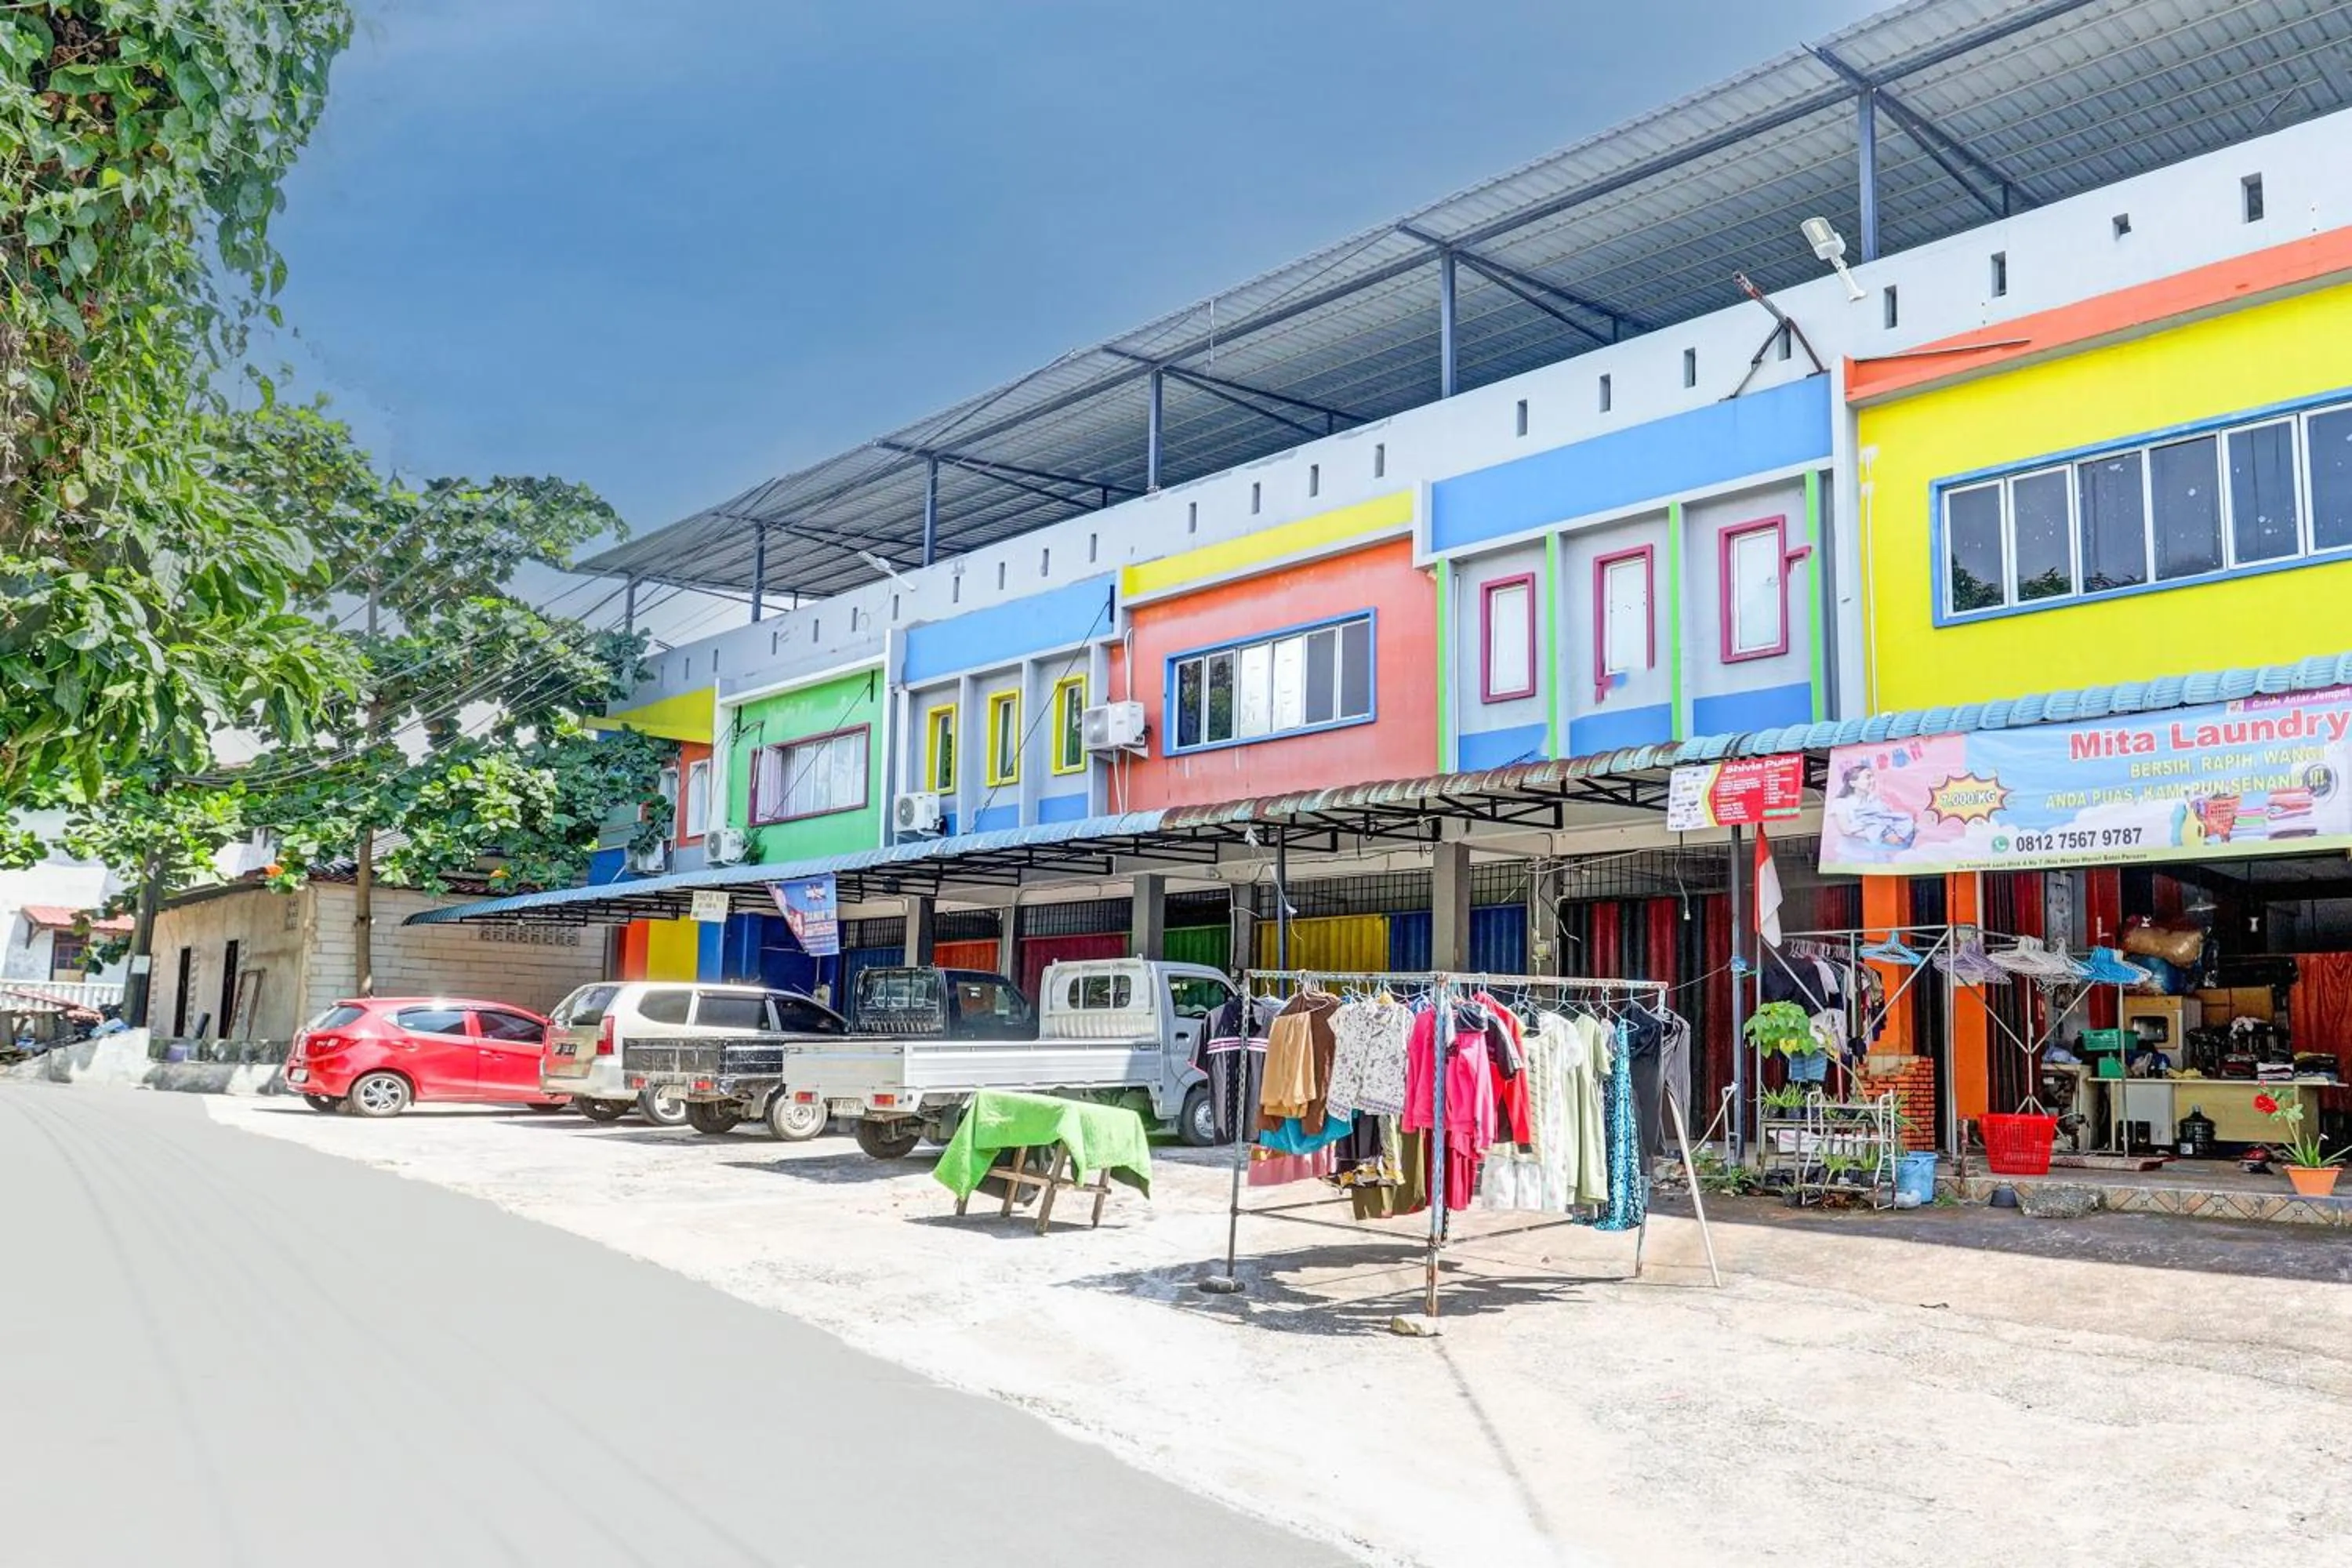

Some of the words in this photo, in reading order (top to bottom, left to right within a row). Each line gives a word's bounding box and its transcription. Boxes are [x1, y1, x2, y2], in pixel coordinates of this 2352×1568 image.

[2071, 728, 2156, 760] Mita
[2170, 707, 2351, 750] Laundry
[2045, 793, 2086, 810] ANDA
[2230, 772, 2304, 794] SENANG
[2016, 833, 2054, 853] 0812
[2058, 830, 2097, 850] 7567
[2102, 827, 2143, 846] 9787
